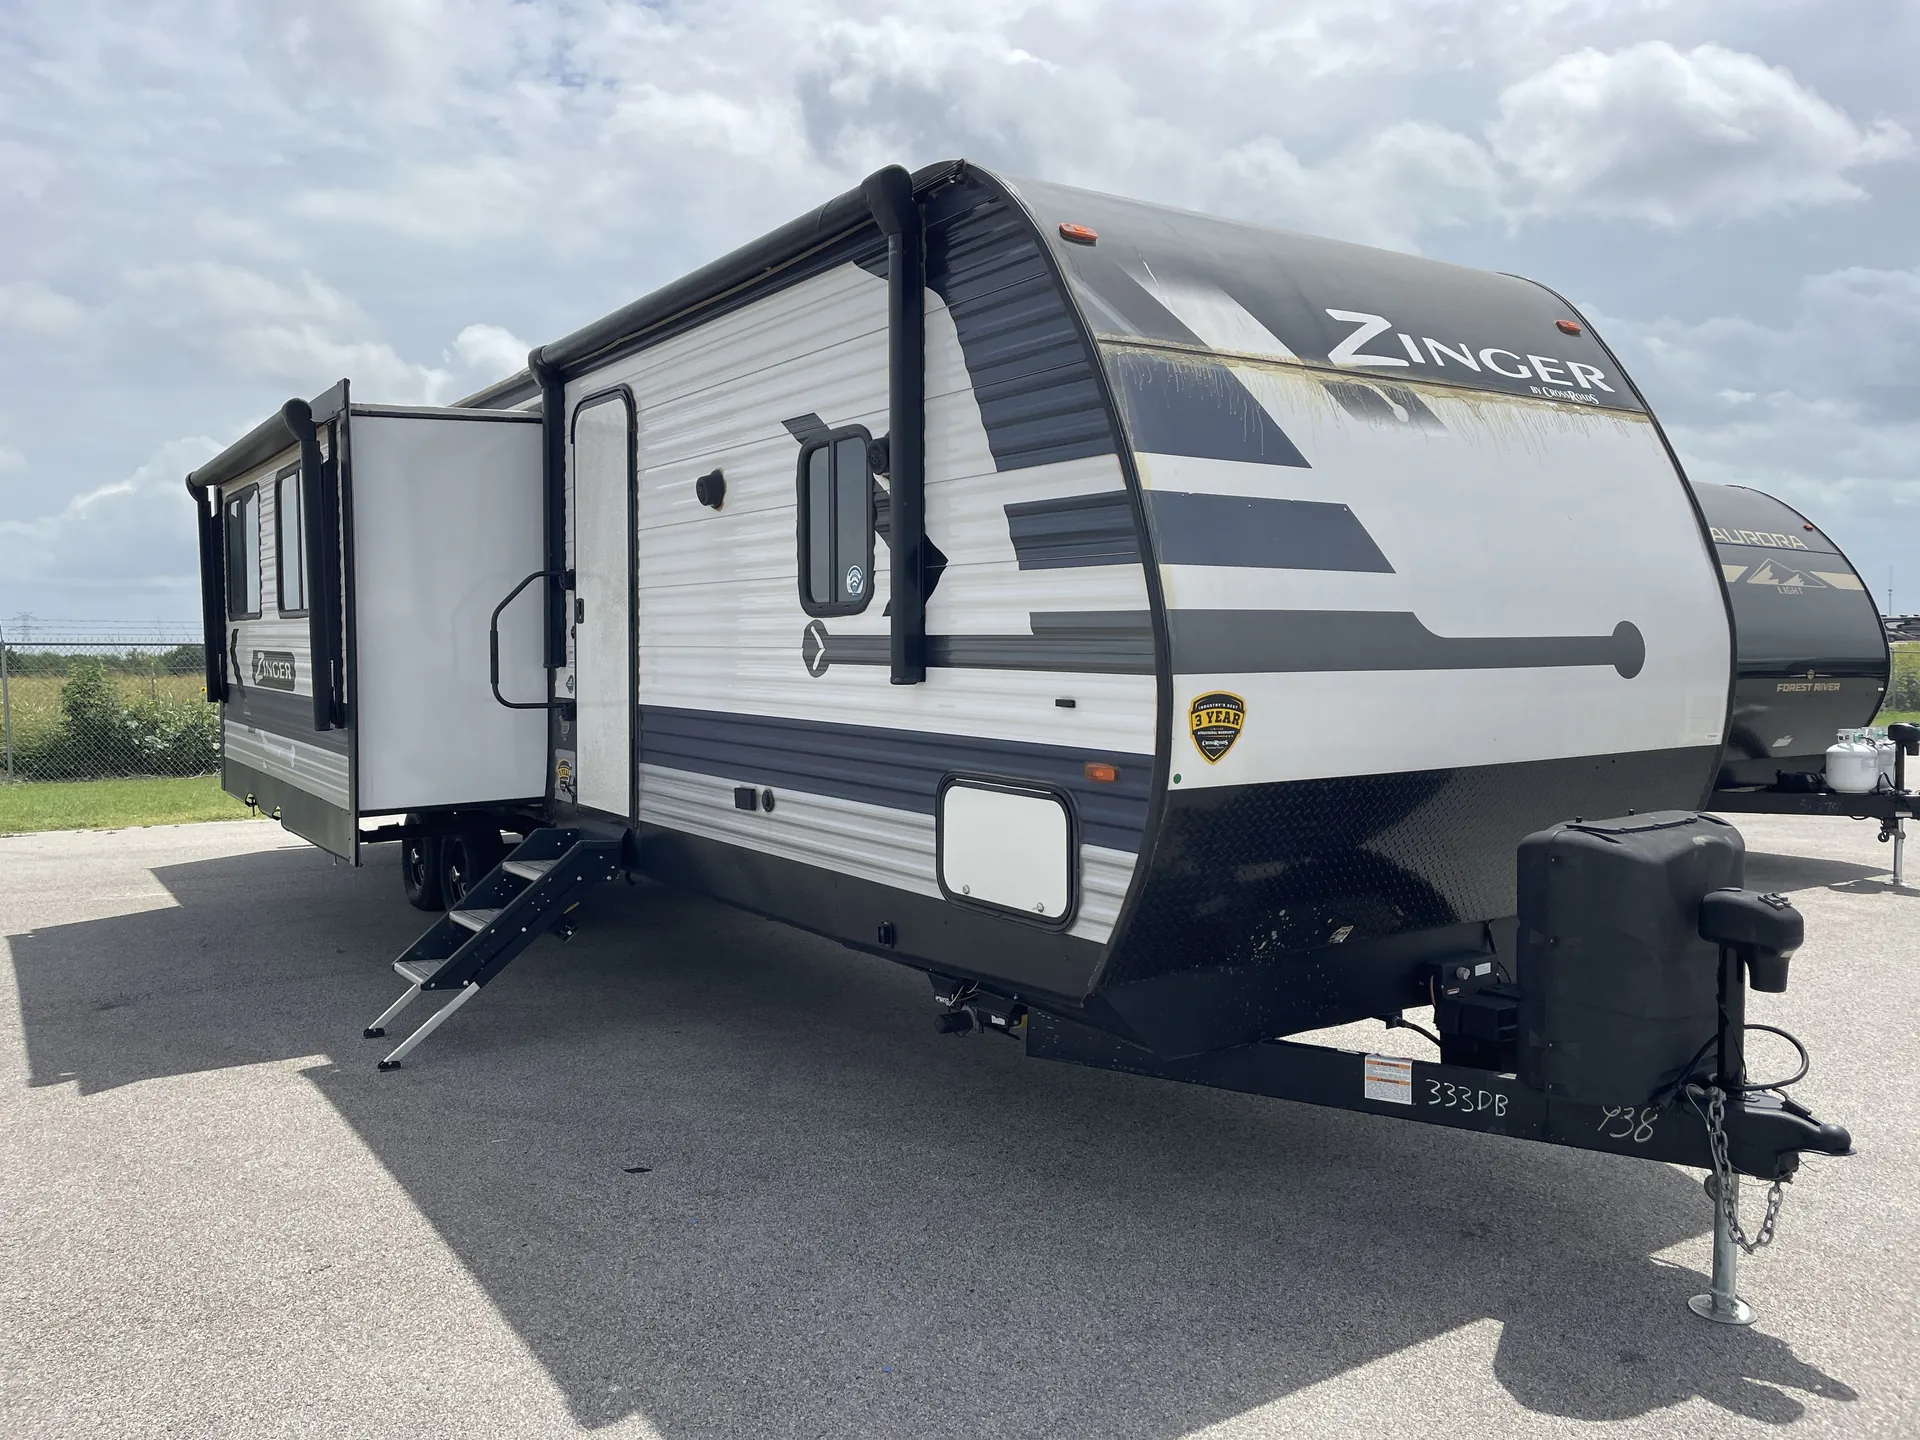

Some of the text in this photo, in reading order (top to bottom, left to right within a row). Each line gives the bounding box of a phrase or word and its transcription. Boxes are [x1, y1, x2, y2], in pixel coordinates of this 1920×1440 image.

[1325, 308, 1615, 393] ZINGER
[1530, 386, 1542, 397] BY
[1709, 527, 1808, 550] AURORA
[1777, 586, 1804, 596] LIGHT
[255, 651, 292, 684] ZINGER
[1776, 683, 1840, 692] FOREST RIVER
[1195, 711, 1240, 727] 3 YEAR
[1425, 1079, 1509, 1117] 333DB
